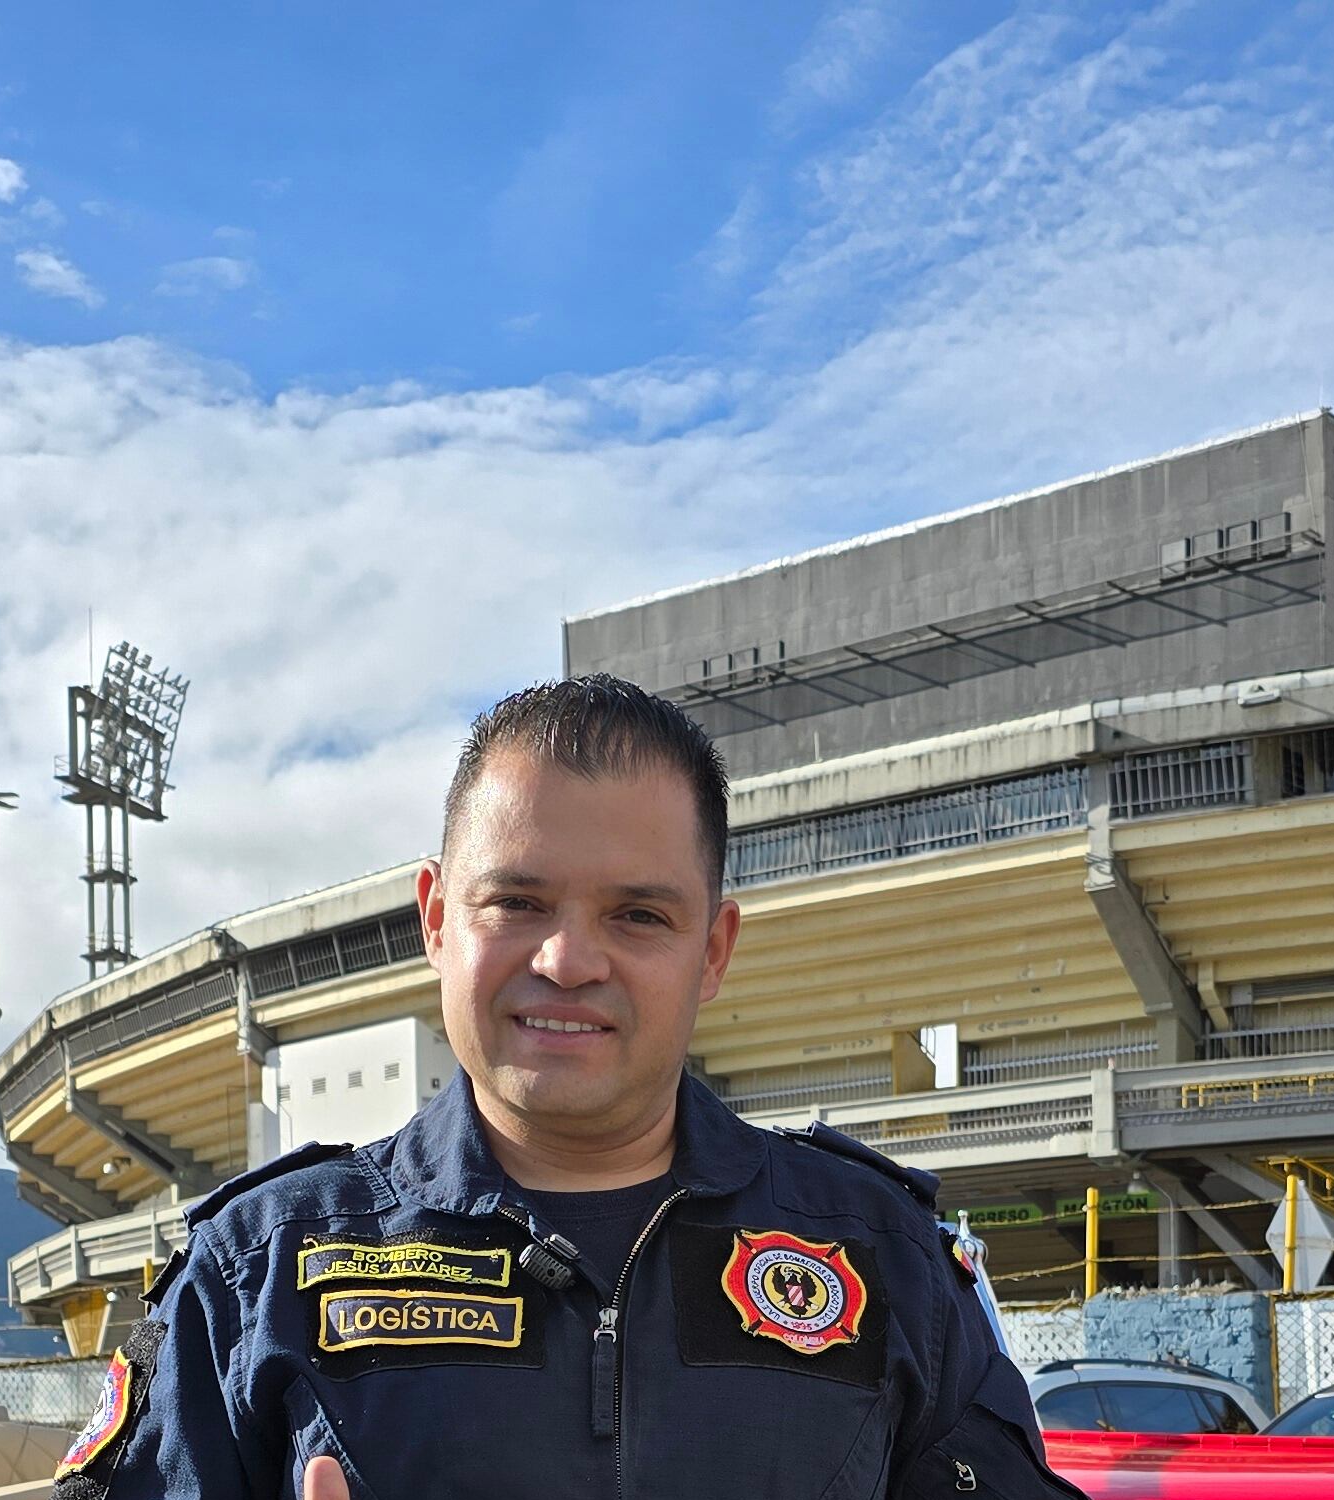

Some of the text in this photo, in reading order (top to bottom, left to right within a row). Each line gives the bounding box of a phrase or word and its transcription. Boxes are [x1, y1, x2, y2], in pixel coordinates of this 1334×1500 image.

[352, 1248, 444, 1264] BOMBERO
[324, 1260, 474, 1279] JESUS ALVAREZ
[337, 1300, 500, 1334] LOGÍSTICA
